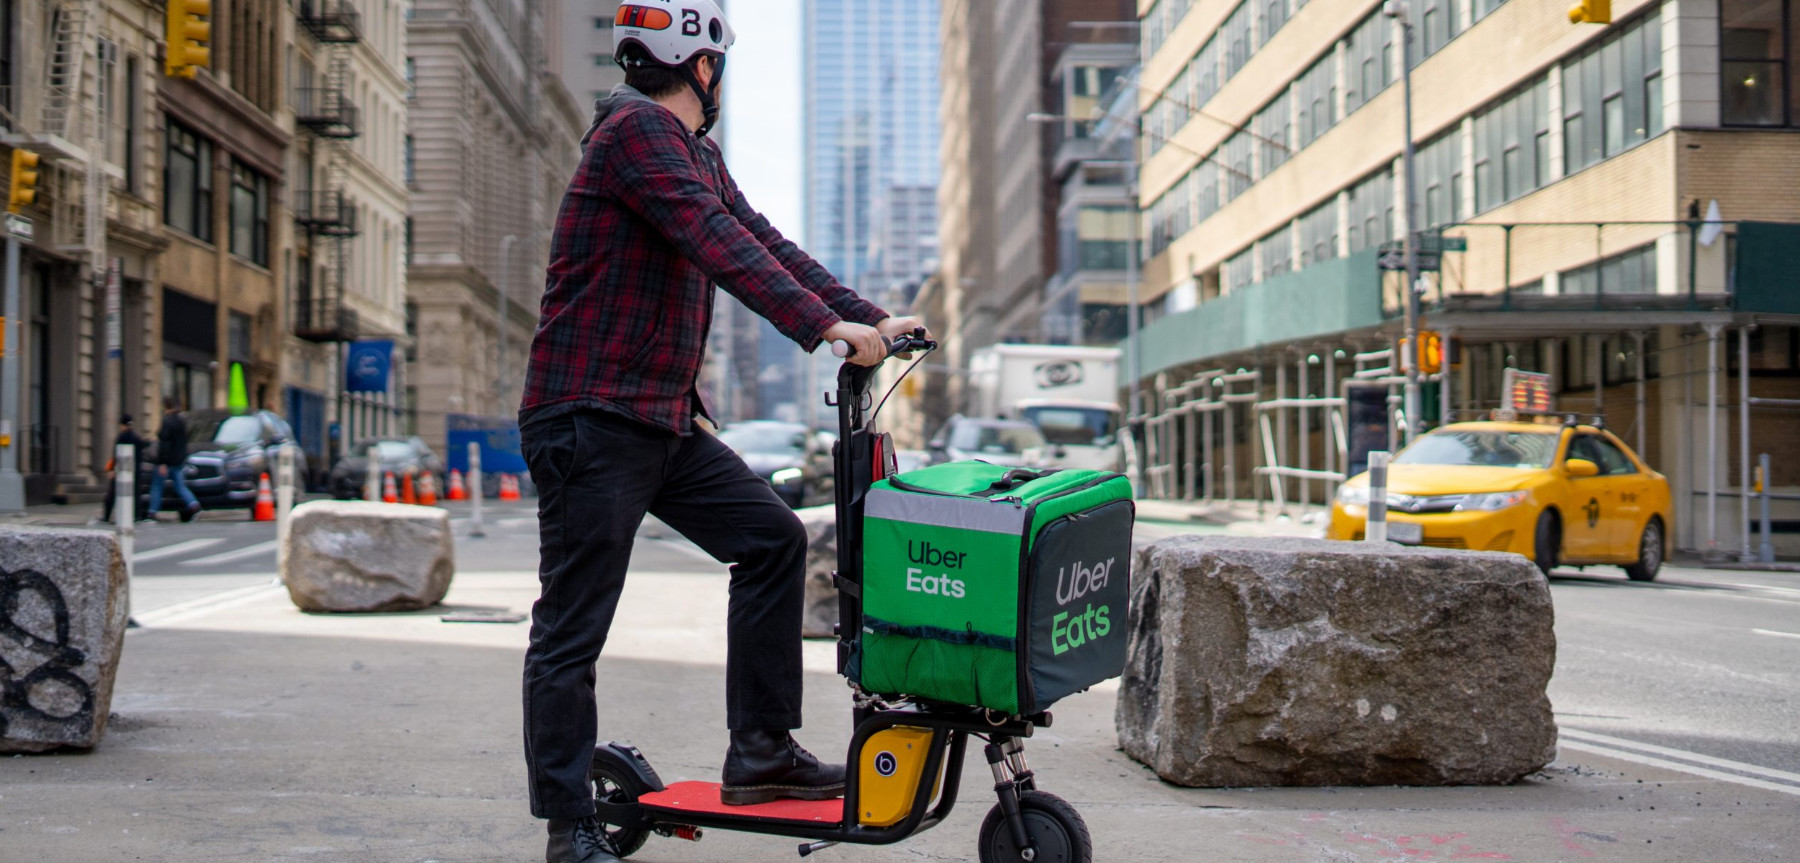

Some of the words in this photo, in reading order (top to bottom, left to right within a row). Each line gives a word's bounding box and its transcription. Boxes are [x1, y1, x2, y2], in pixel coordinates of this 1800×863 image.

[681, 8, 701, 36] B
[908, 539, 967, 569] Uber
[906, 567, 966, 598] Eats
[1056, 556, 1115, 606] Uber
[1051, 603, 1111, 656] Eats
